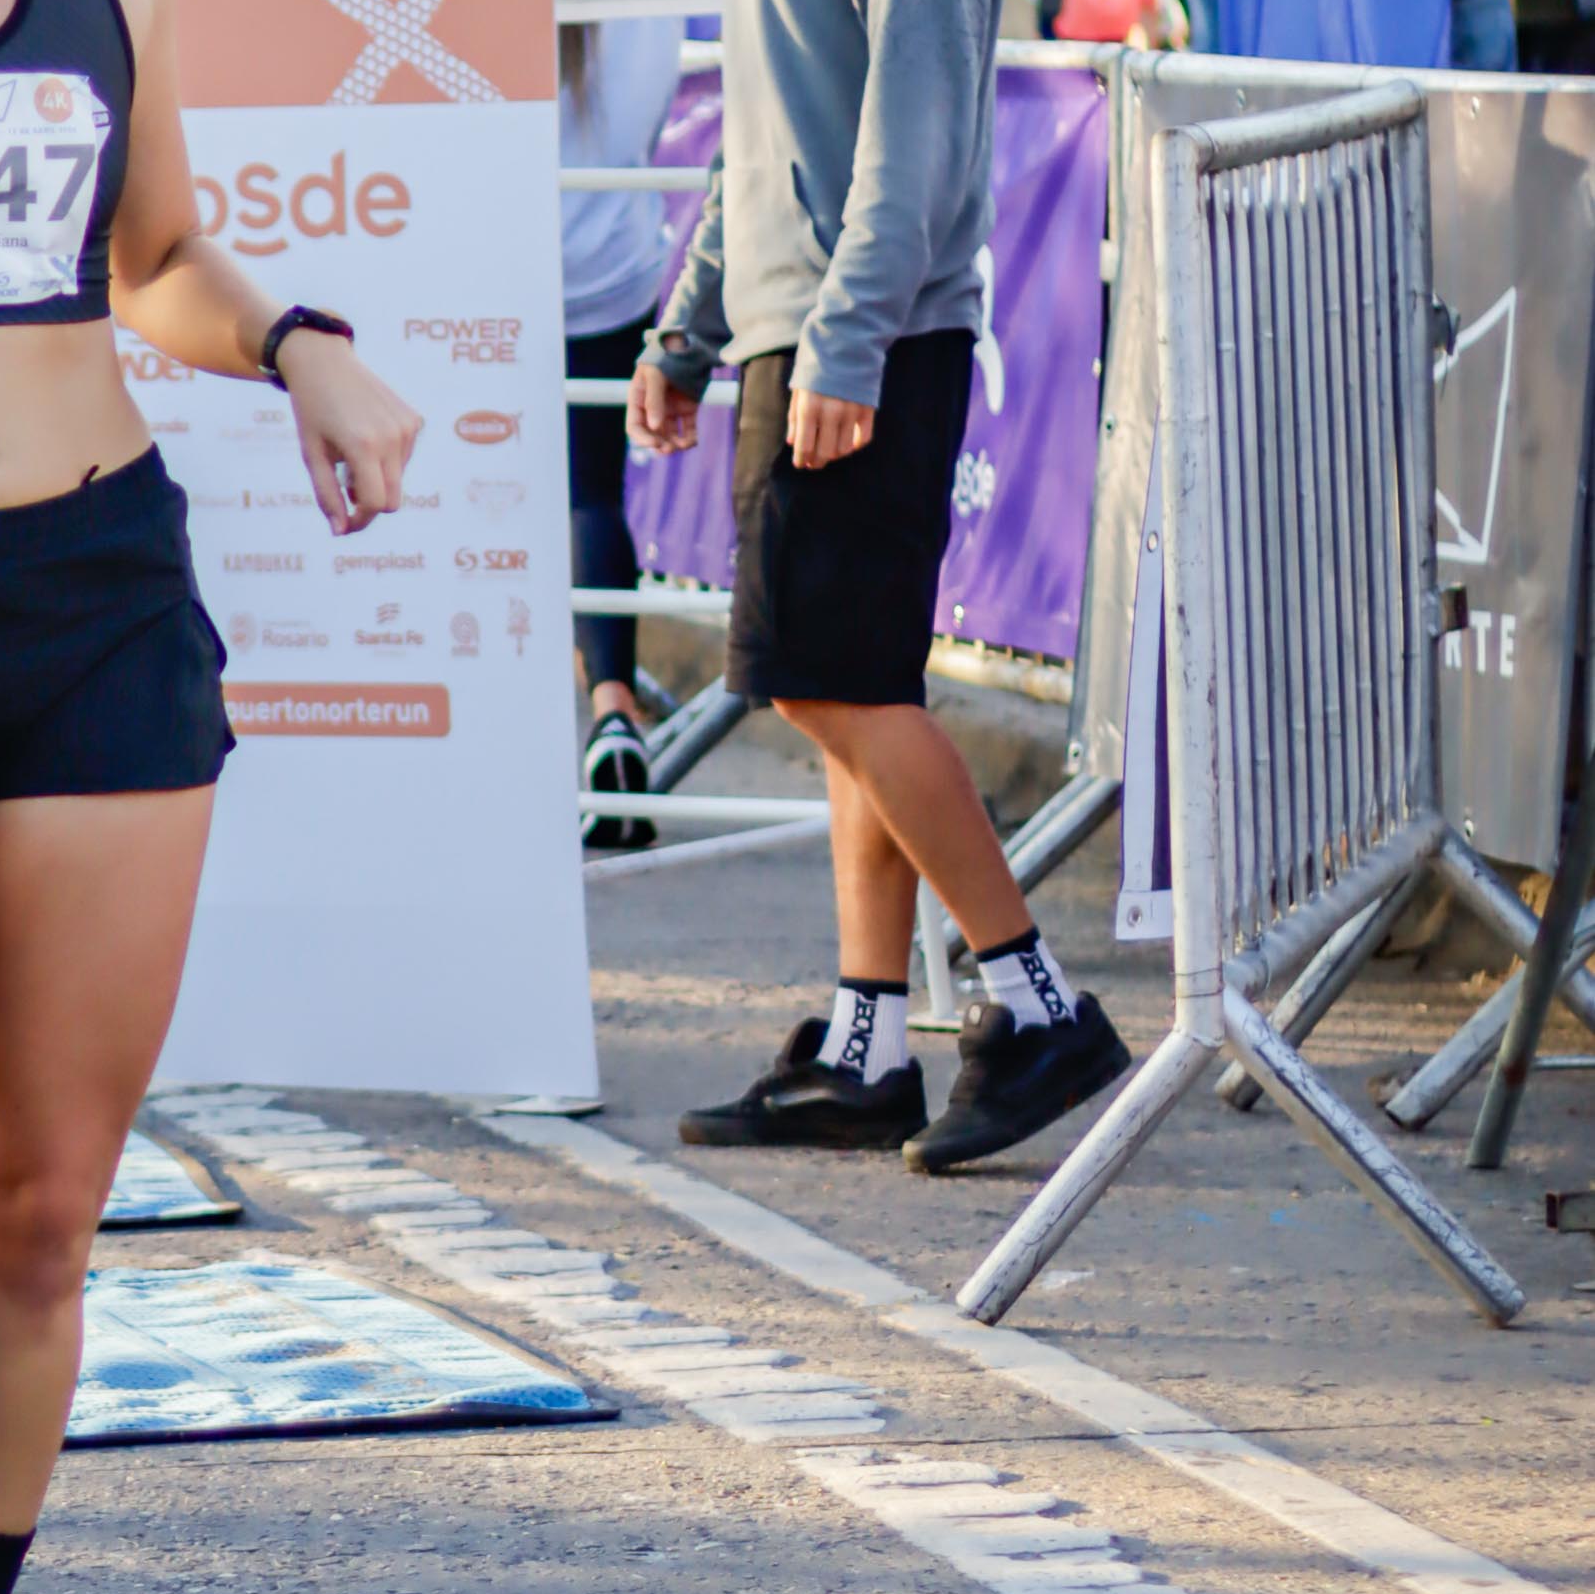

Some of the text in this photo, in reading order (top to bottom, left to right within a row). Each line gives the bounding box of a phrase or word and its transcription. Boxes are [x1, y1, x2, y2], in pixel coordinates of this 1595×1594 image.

[403, 318, 522, 341] POWER
[952, 450, 996, 516] sde
[333, 553, 426, 574] gemplast
[262, 628, 329, 648] Rosario
[355, 629, 425, 645] Santa Fe
